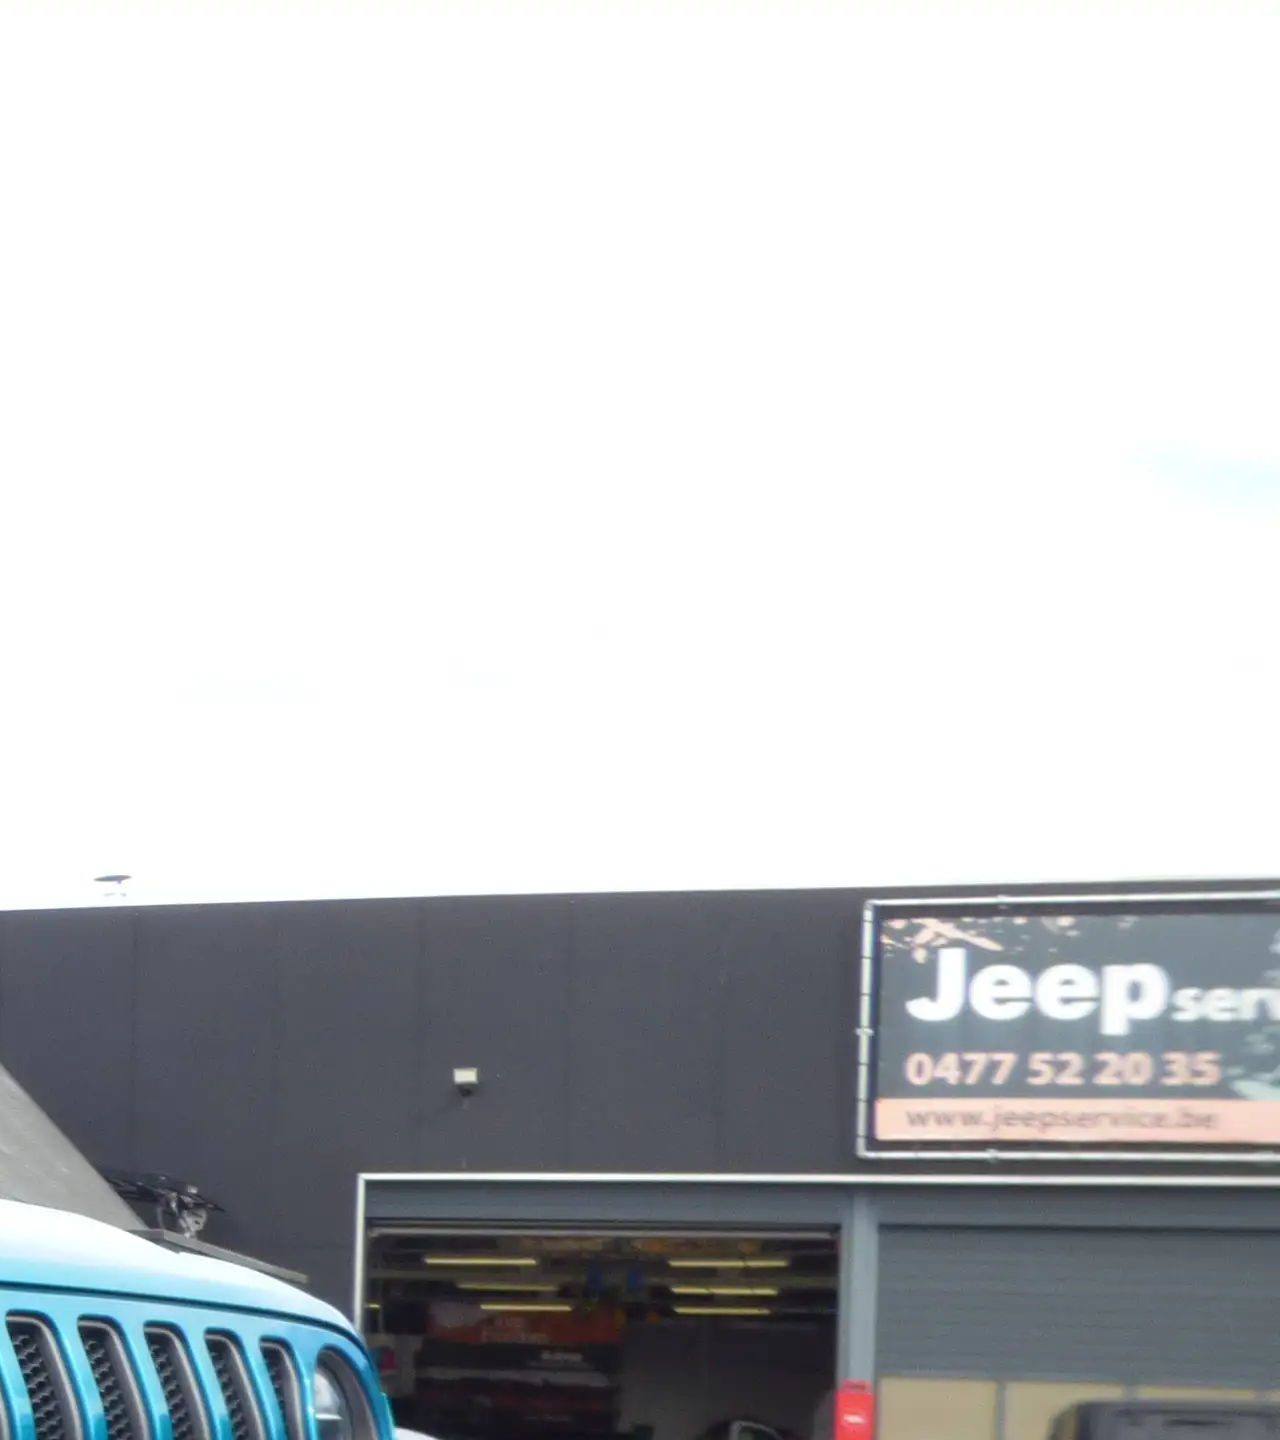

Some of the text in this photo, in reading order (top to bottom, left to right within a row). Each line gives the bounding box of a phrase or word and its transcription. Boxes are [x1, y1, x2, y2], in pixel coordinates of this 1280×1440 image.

[905, 1051, 1222, 1086] 0477 52 20 35
[906, 1104, 1220, 1135] www.jeepservice.be
